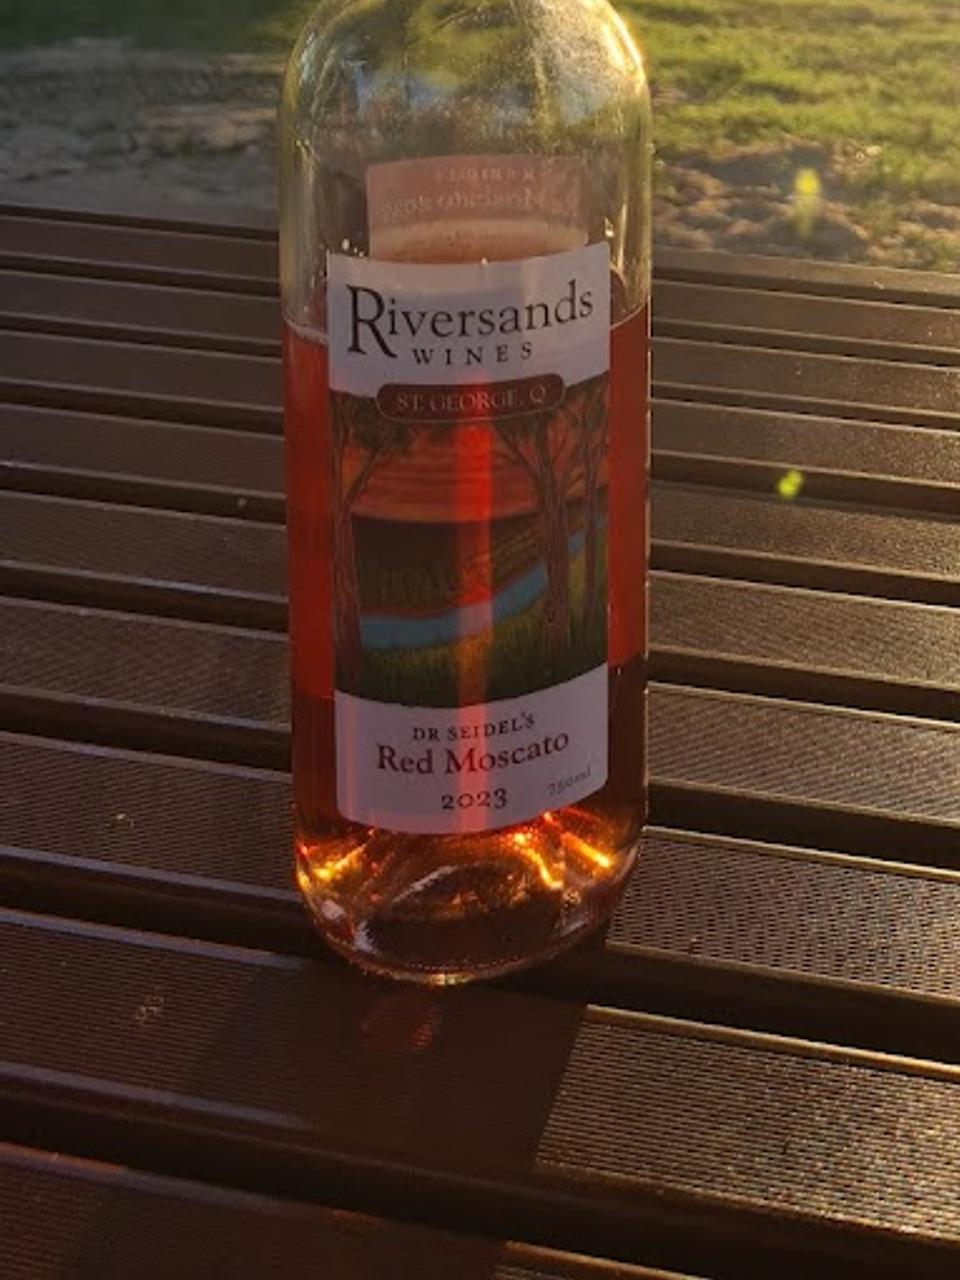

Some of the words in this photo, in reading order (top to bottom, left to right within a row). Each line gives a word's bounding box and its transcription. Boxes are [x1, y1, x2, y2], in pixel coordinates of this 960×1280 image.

[346, 279, 594, 359] Riversands
[413, 341, 533, 366] WINES
[413, 727, 440, 741] DR
[376, 743, 434, 774] Red
[445, 732, 570, 773] Moscato
[440, 788, 508, 810] 2023
